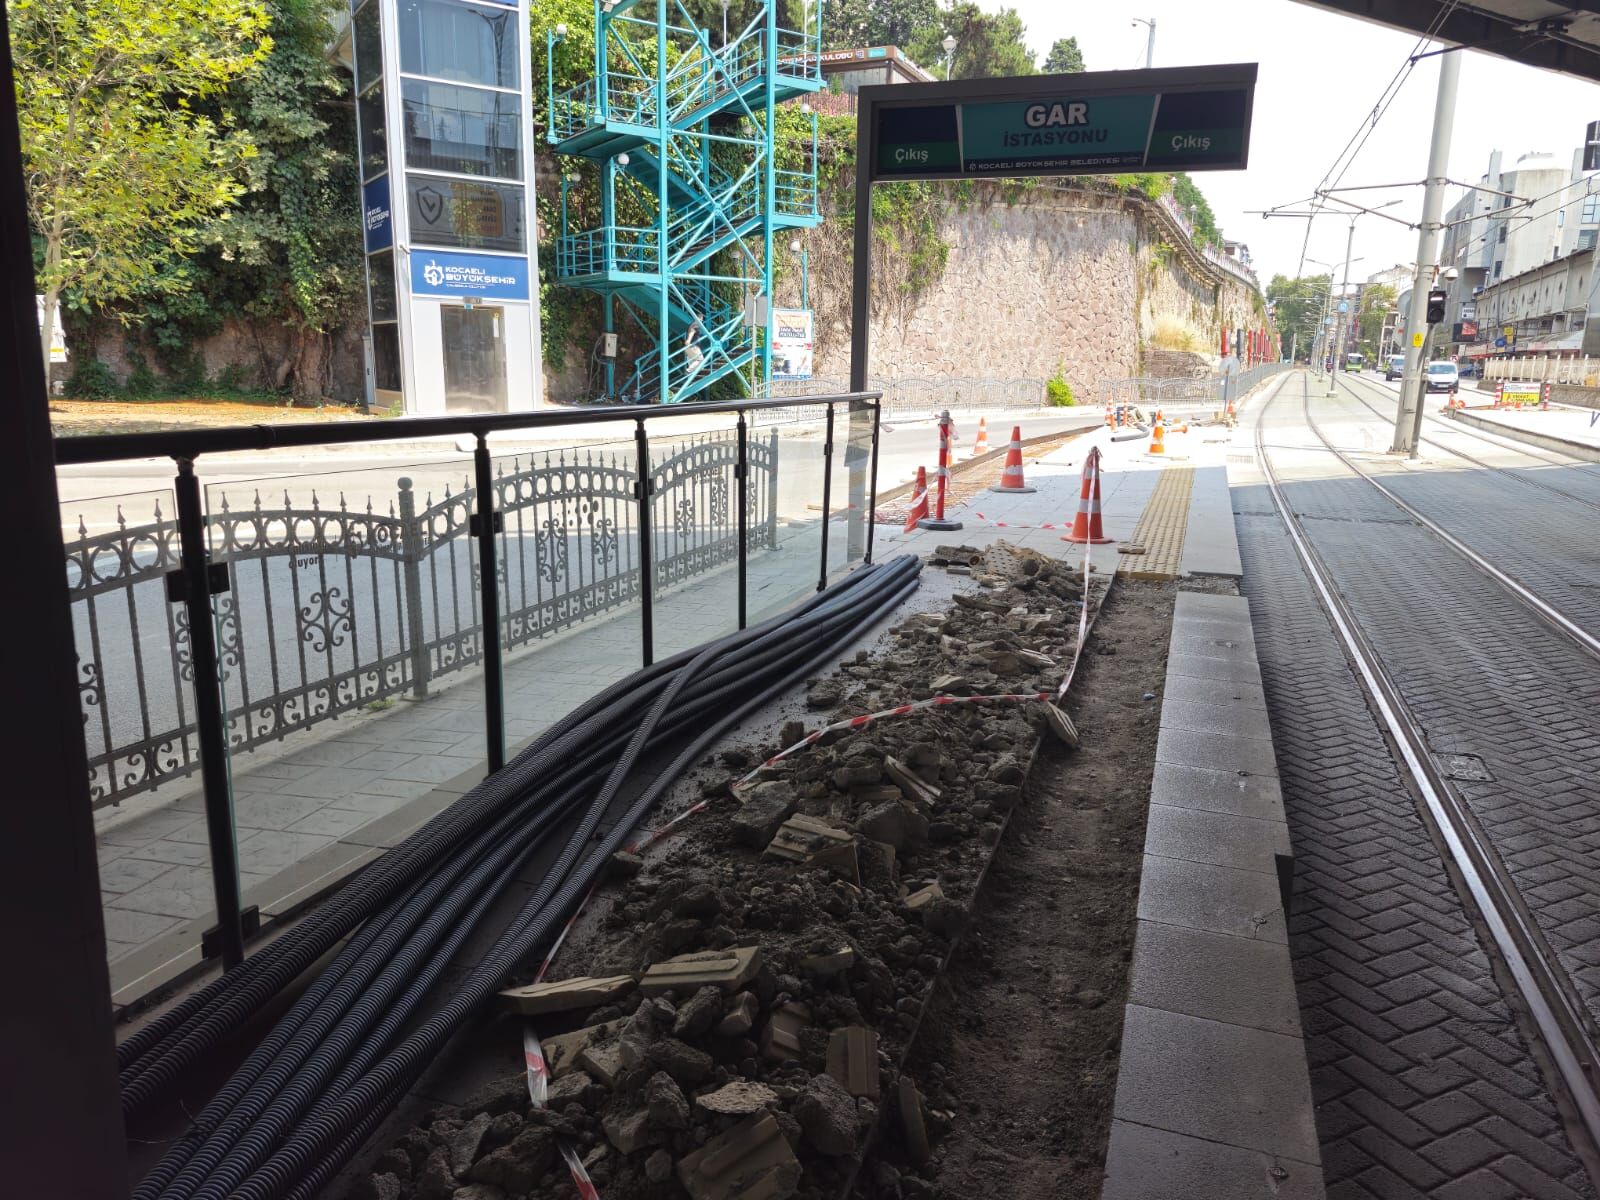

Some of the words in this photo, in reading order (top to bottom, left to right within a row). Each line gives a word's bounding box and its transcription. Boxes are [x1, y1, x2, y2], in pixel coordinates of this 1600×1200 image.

[1025, 102, 1088, 127] GAR
[1003, 128, 1109, 147] İSTASYONU
[1171, 135, 1211, 151] Çıkış
[895, 148, 929, 163] Çıkış
[445, 273, 516, 285] BÜYÜKŞEHİR
